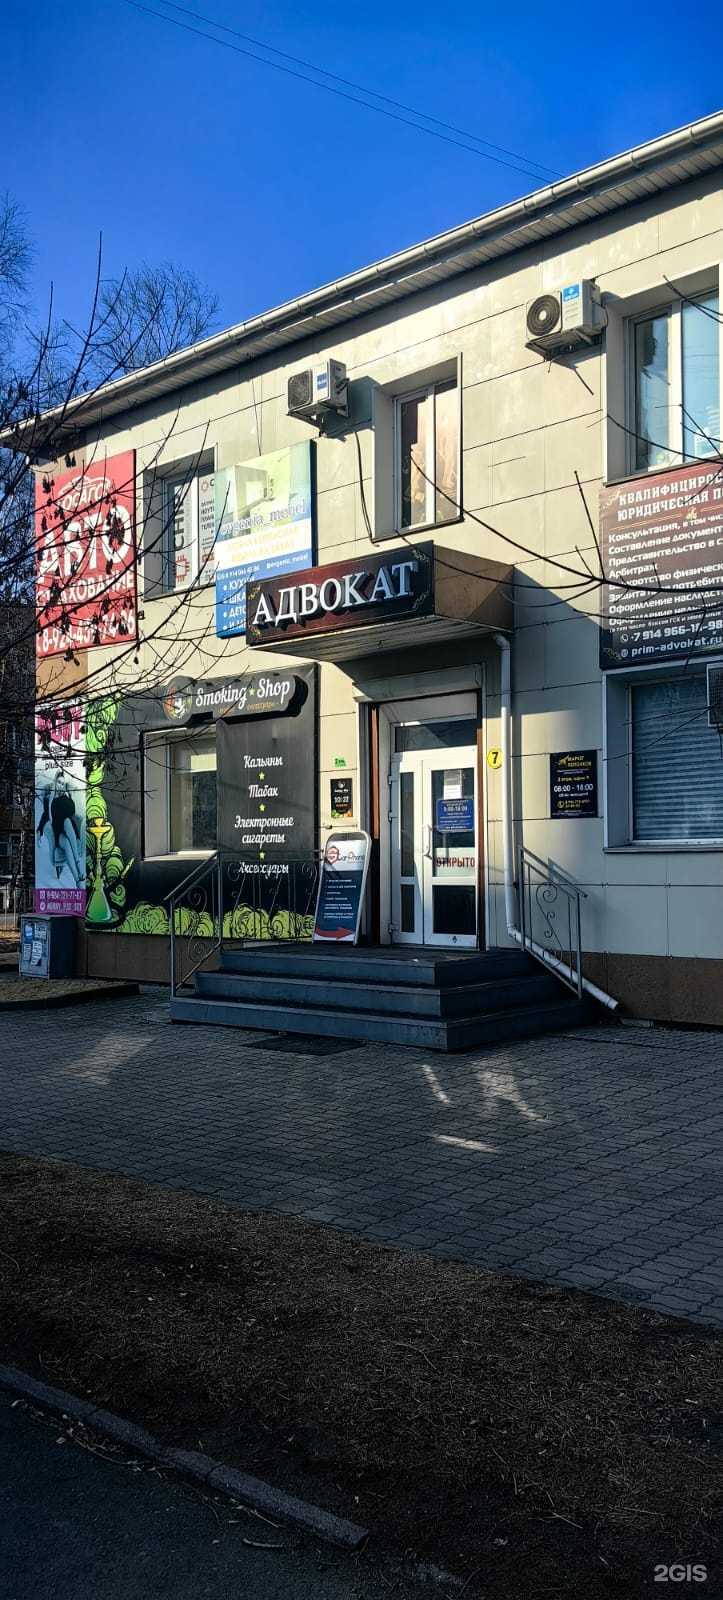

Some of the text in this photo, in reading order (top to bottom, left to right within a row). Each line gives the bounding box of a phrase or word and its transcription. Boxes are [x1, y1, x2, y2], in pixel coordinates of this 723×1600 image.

[617, 490, 709, 522] ЮРИДИЧЕСКАЯ
[609, 536, 671, 555] Составление
[609, 542, 707, 566] Представительство
[36, 569, 135, 607] СТАХОВАНИЕ
[252, 561, 418, 627] АДВОКАТ
[643, 629, 662, 640] 914
[195, 677, 290, 710] Smoking Shop
[243, 755, 283, 768] Кальяны
[492, 751, 499, 764] 7
[248, 785, 279, 798] Табак
[234, 815, 294, 833] Электронные
[241, 834, 285, 849] сигареты
[435, 857, 475, 868] ОТКРЫТО
